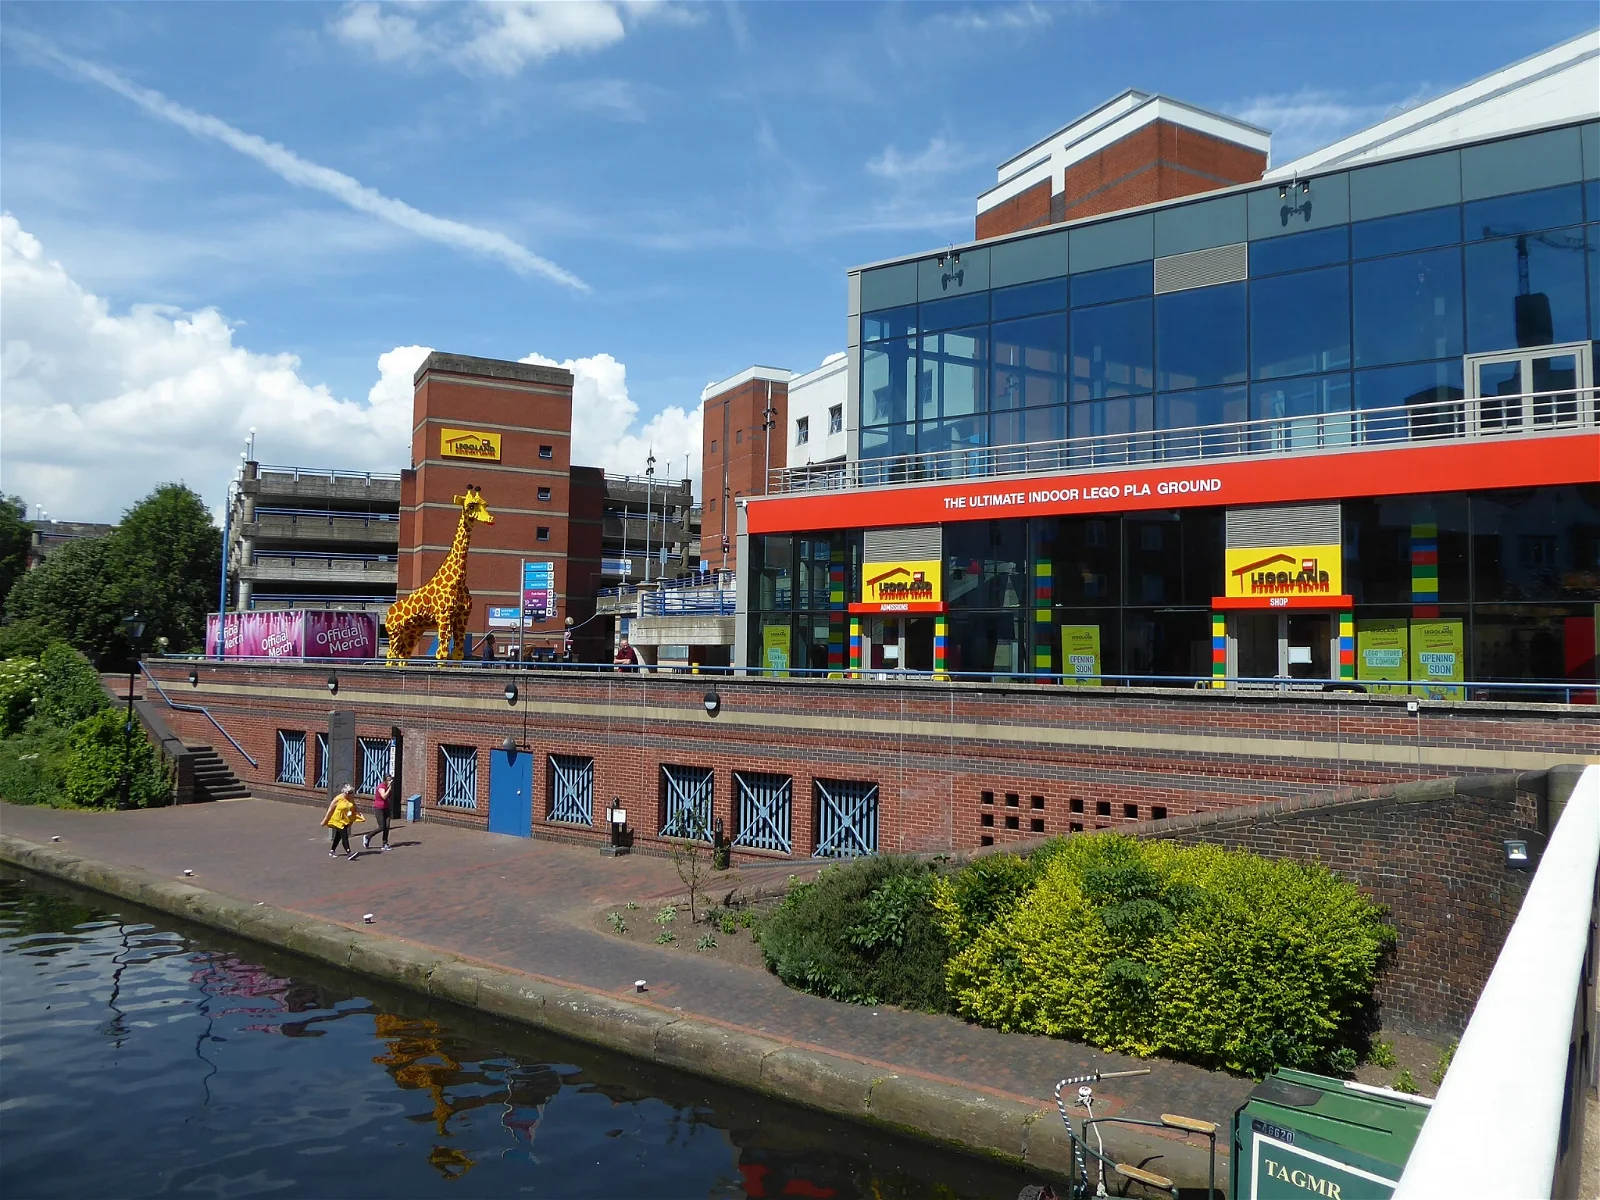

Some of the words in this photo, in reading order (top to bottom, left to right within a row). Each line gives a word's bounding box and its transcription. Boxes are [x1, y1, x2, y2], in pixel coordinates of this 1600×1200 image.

[456, 442, 496, 452] LEGOLAND
[944, 497, 966, 509] THE
[969, 493, 1025, 507] ULTIMATE
[1028, 488, 1079, 503] INDOOR
[1083, 486, 1120, 500] LEGO
[1124, 483, 1151, 497] PLA
[1157, 479, 1221, 495] GROUND
[1251, 570, 1330, 584] LEGOLAND
[1269, 597, 1289, 607] SHOP
[880, 603, 909, 612] ADMISSIONS
[316, 622, 361, 645] Official
[261, 628, 288, 651] Official
[329, 634, 369, 654] Merch
[268, 639, 292, 657] Merch
[1069, 655, 1094, 664] OPENING
[1375, 658, 1398, 666] COMING
[1421, 654, 1454, 663] OPENING
[1075, 665, 1092, 673] SOON
[1429, 664, 1452, 674] SOON
[1264, 1158, 1342, 1200] TAGMR
